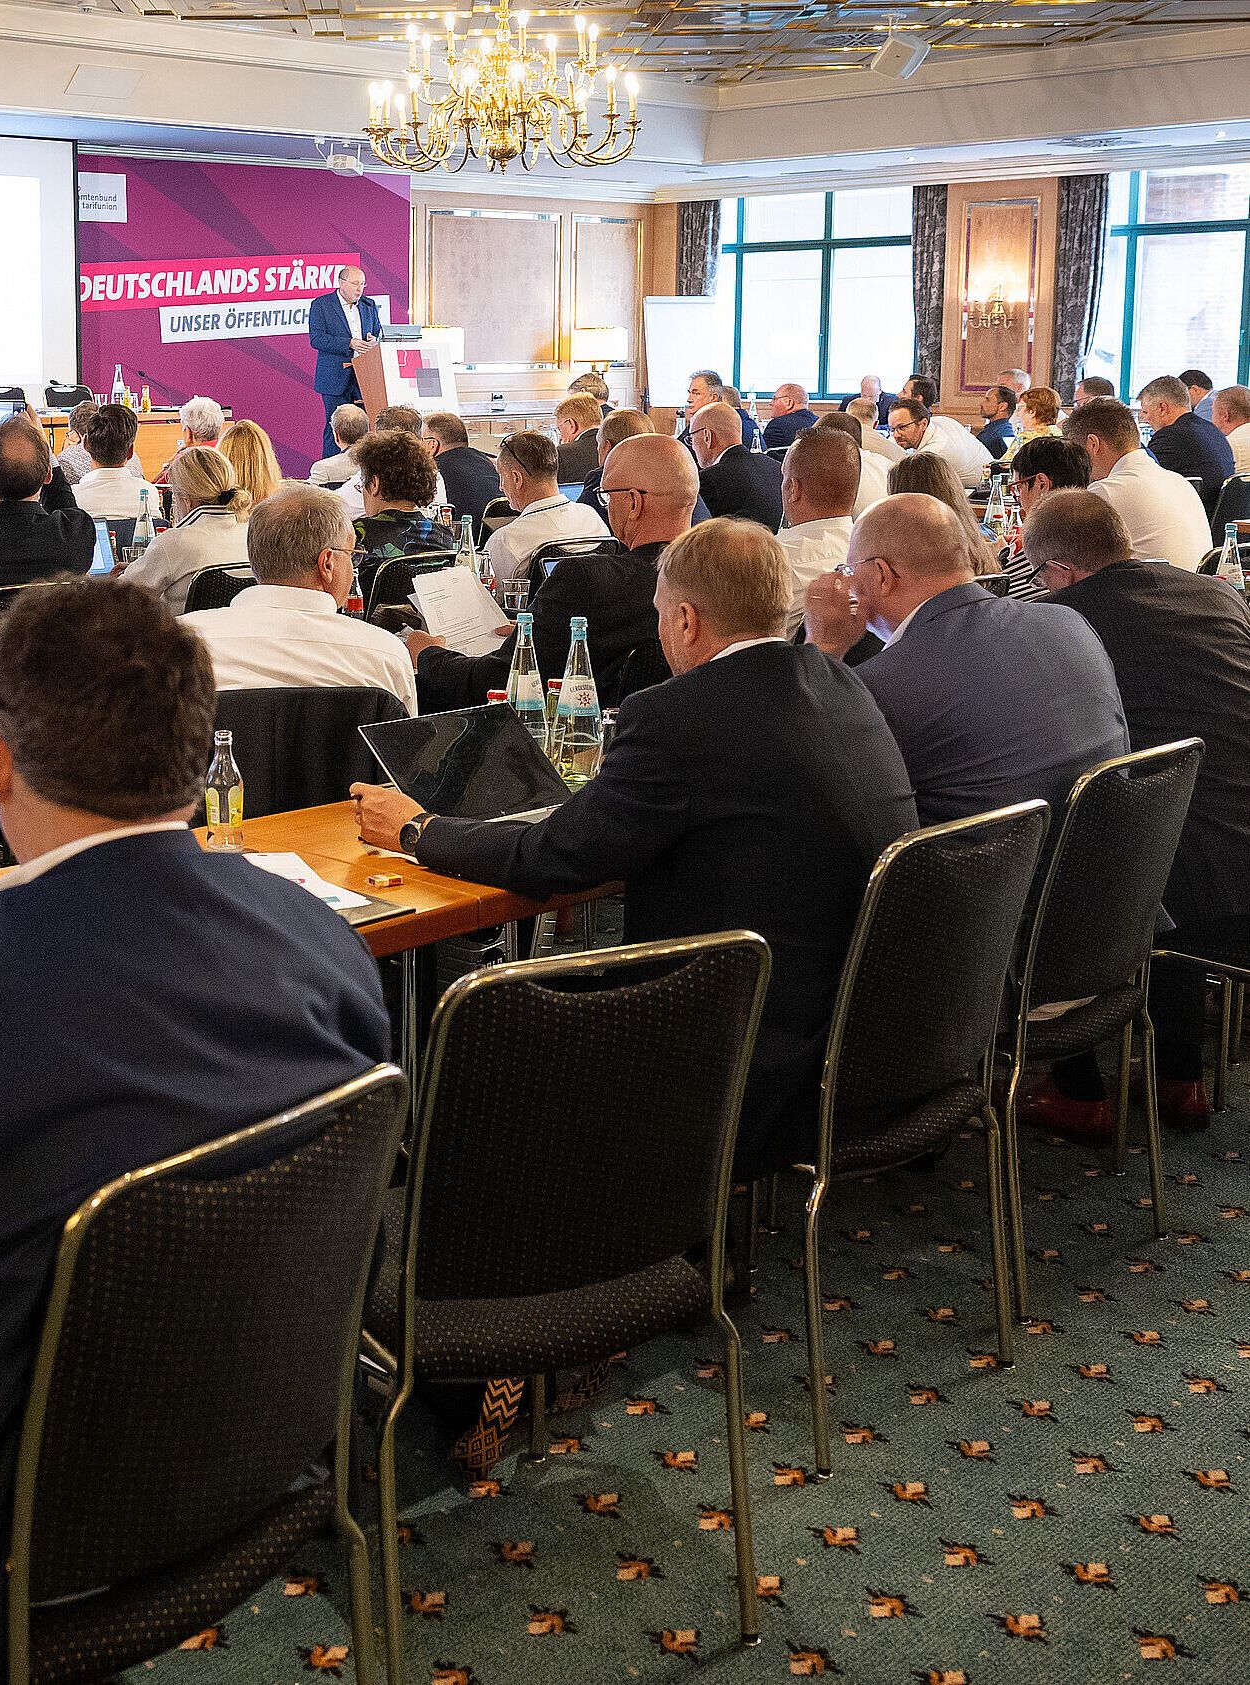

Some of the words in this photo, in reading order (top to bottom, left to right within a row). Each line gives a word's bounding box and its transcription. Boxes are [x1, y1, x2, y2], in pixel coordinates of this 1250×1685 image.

[82, 202, 117, 210] tarifunion
[79, 267, 259, 302] DEUTSCHLANDS
[169, 313, 221, 334] UNSER
